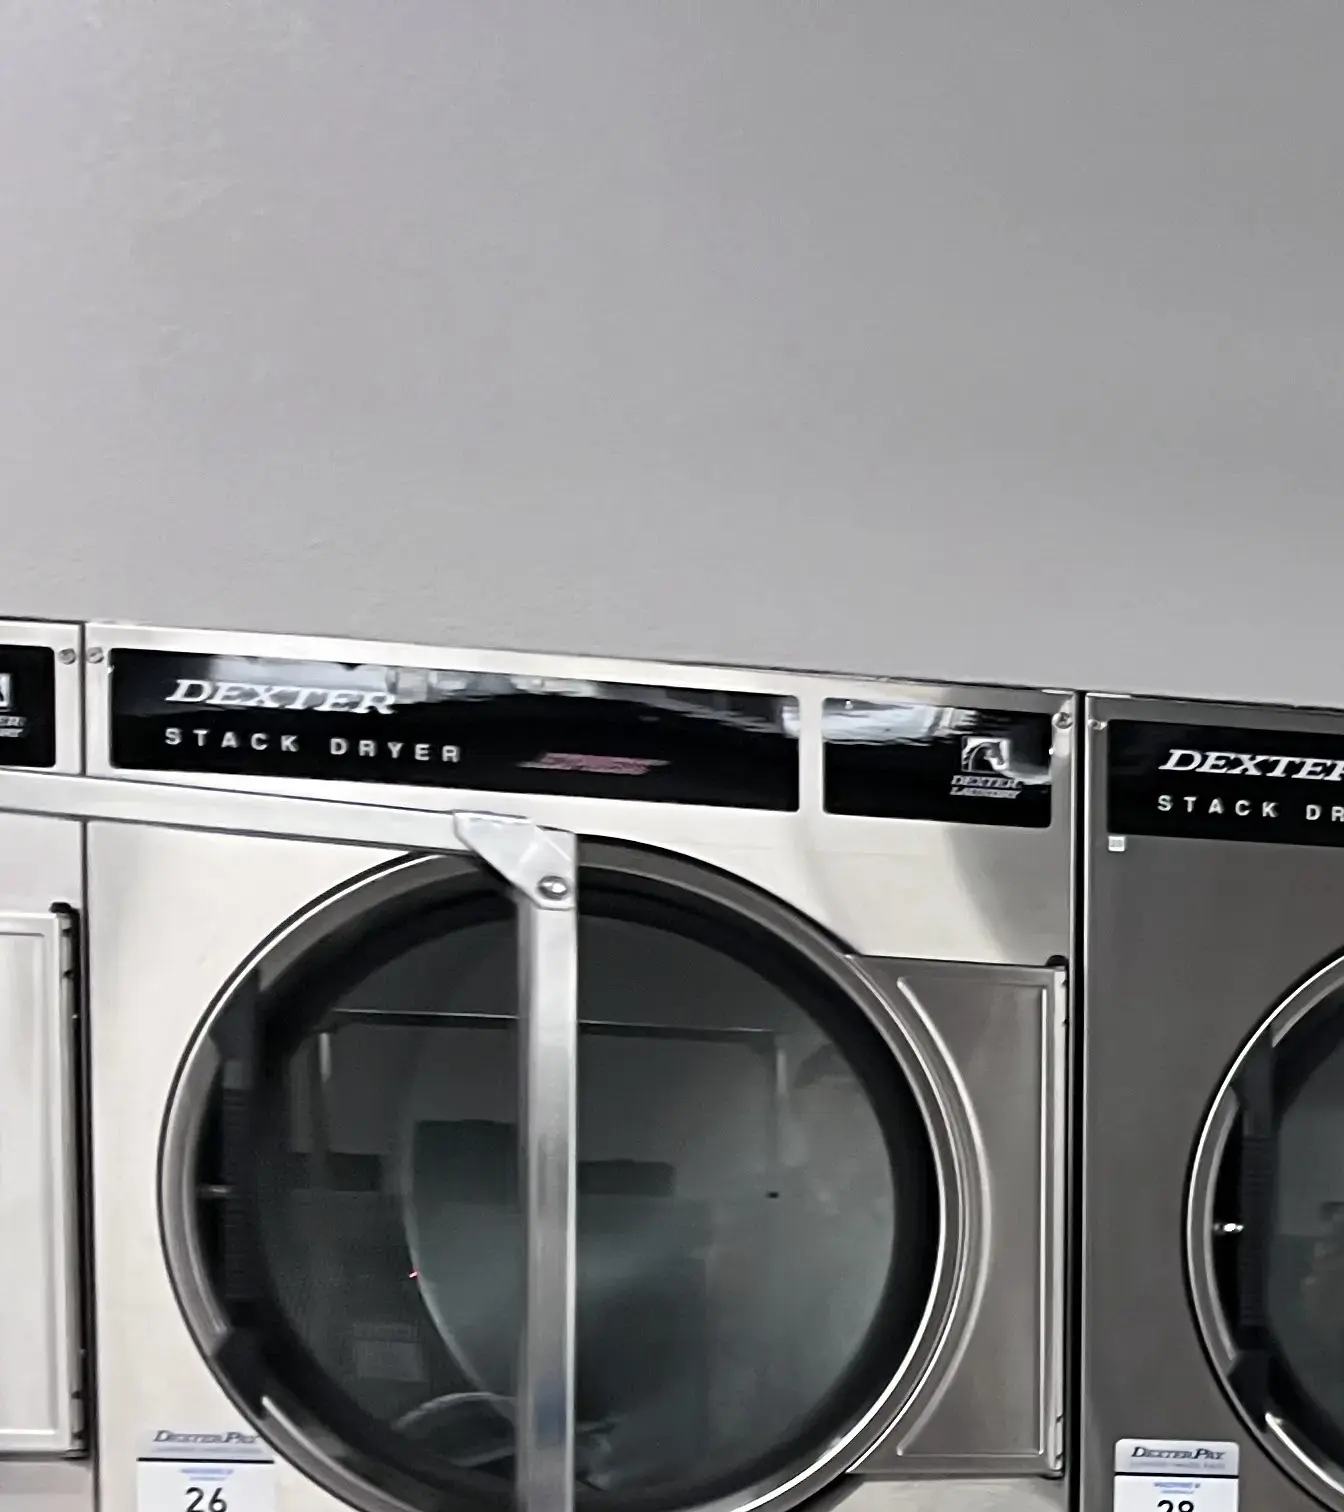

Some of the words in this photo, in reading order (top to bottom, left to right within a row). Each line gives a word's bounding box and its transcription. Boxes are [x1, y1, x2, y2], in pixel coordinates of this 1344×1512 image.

[164, 677, 397, 716] DEXTER
[164, 727, 301, 754] STACK
[329, 735, 464, 764] DRYER
[1156, 794, 1280, 820] STACK
